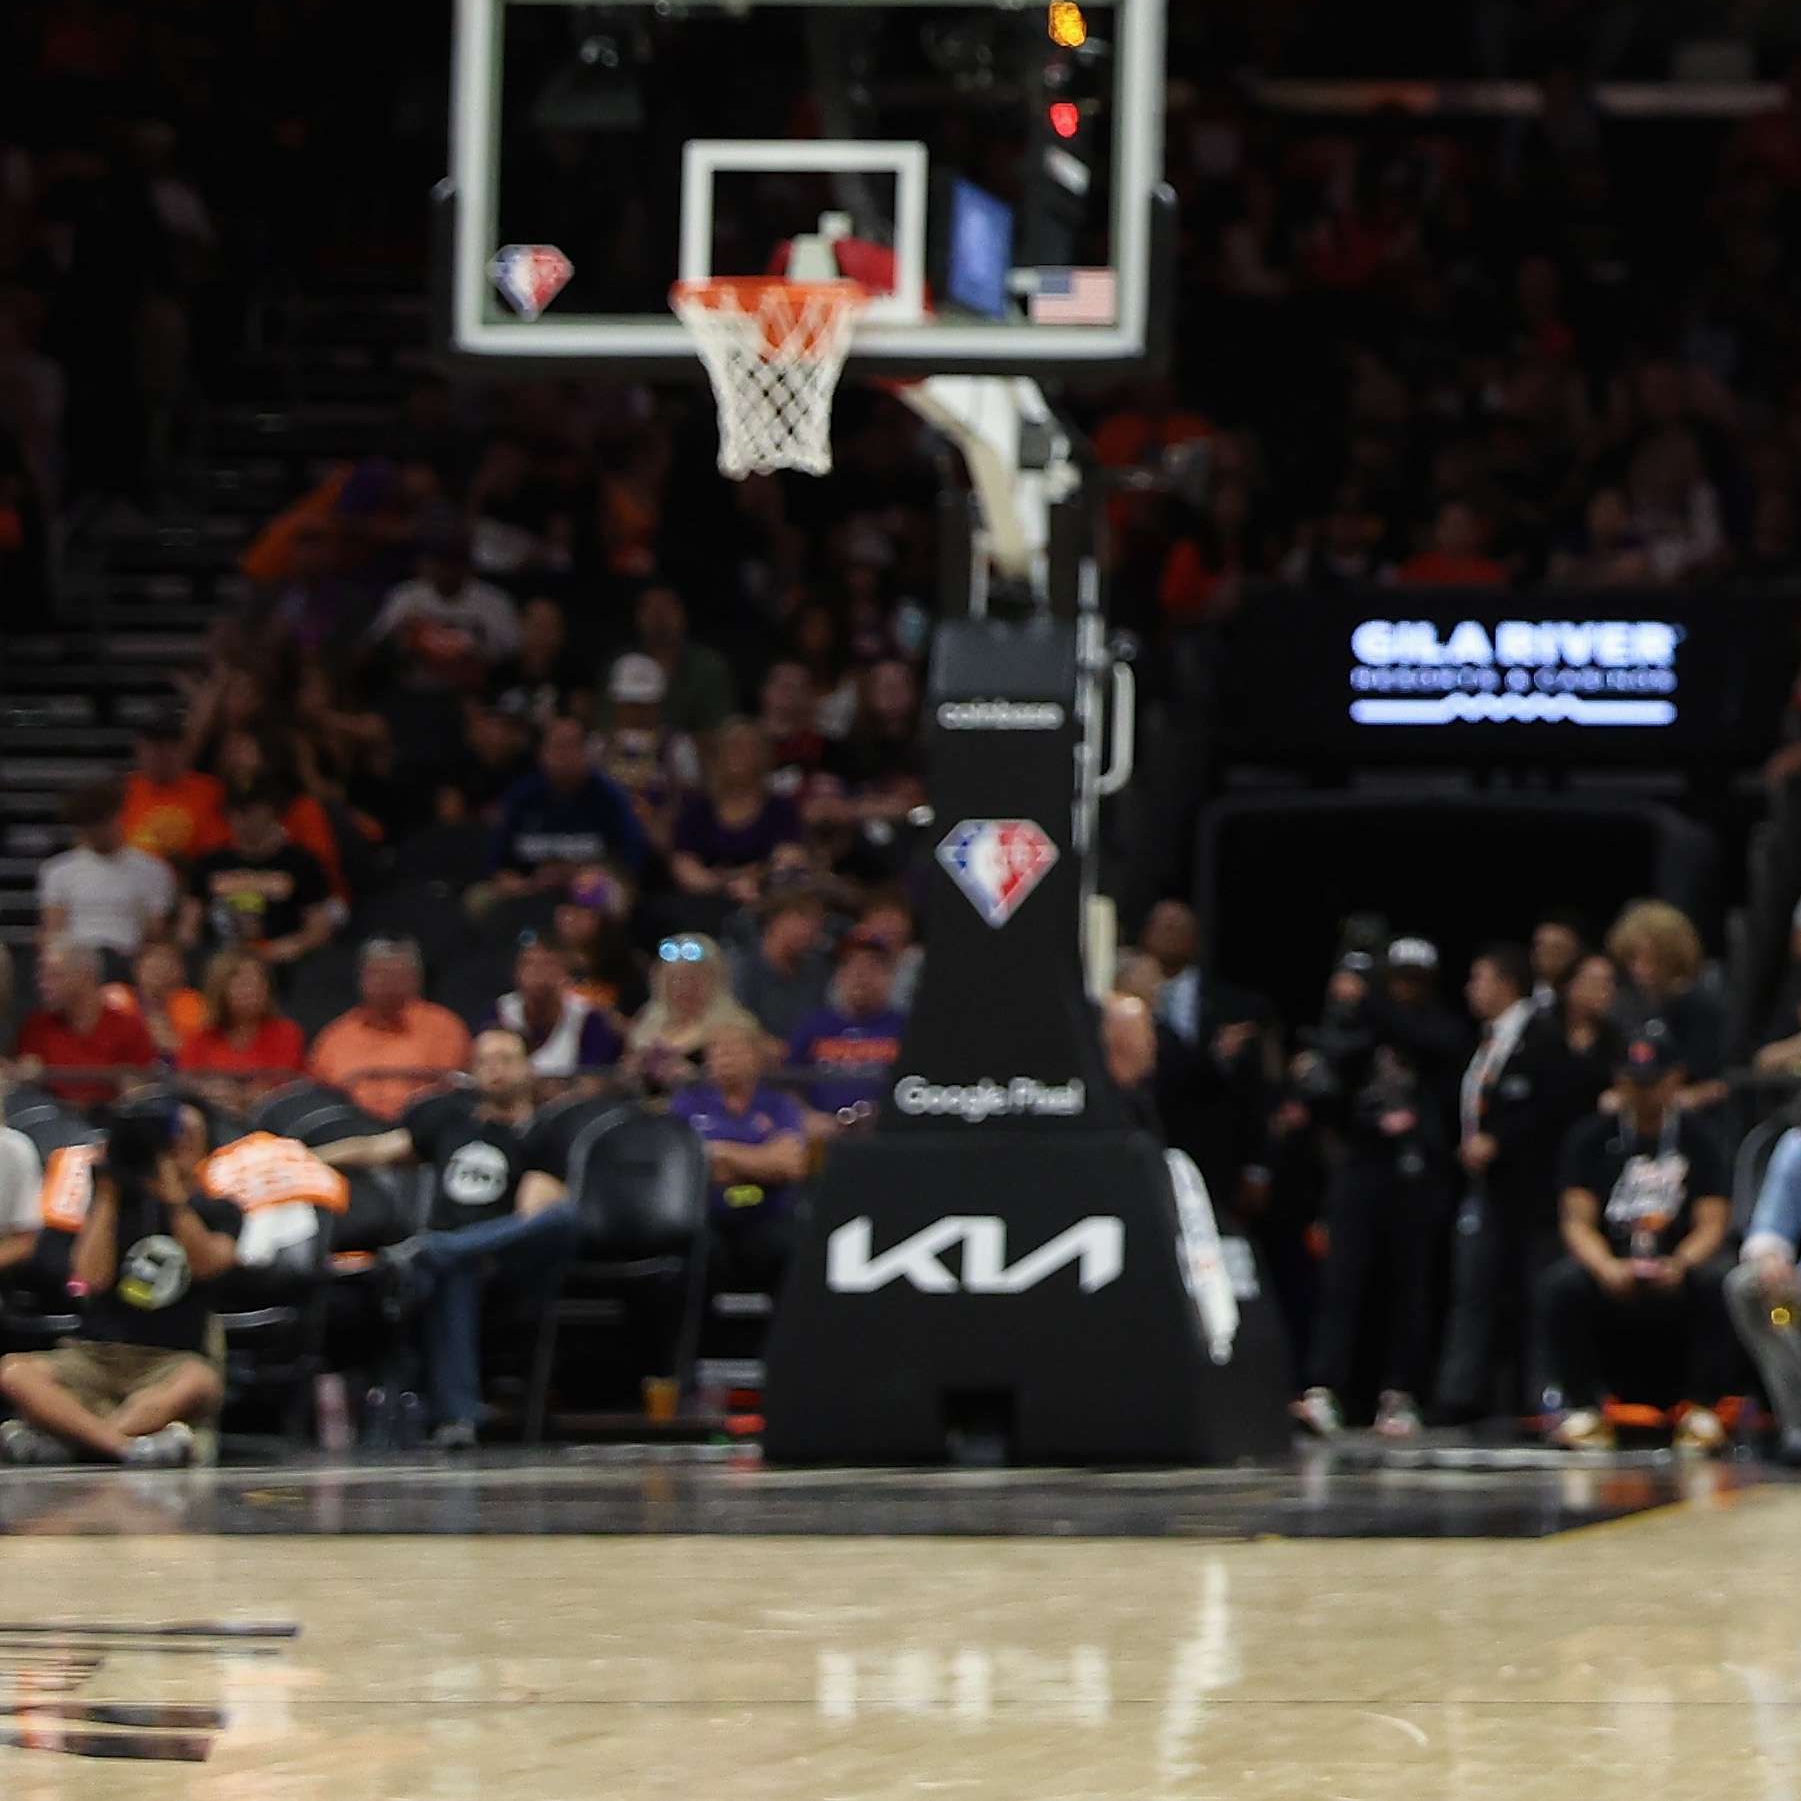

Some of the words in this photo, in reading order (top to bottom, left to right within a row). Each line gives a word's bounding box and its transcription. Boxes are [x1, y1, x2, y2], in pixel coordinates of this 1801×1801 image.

[1495, 619, 1677, 667] RIVER
[895, 1075, 1009, 1123] Google
[826, 1214, 1126, 1295] KIA
